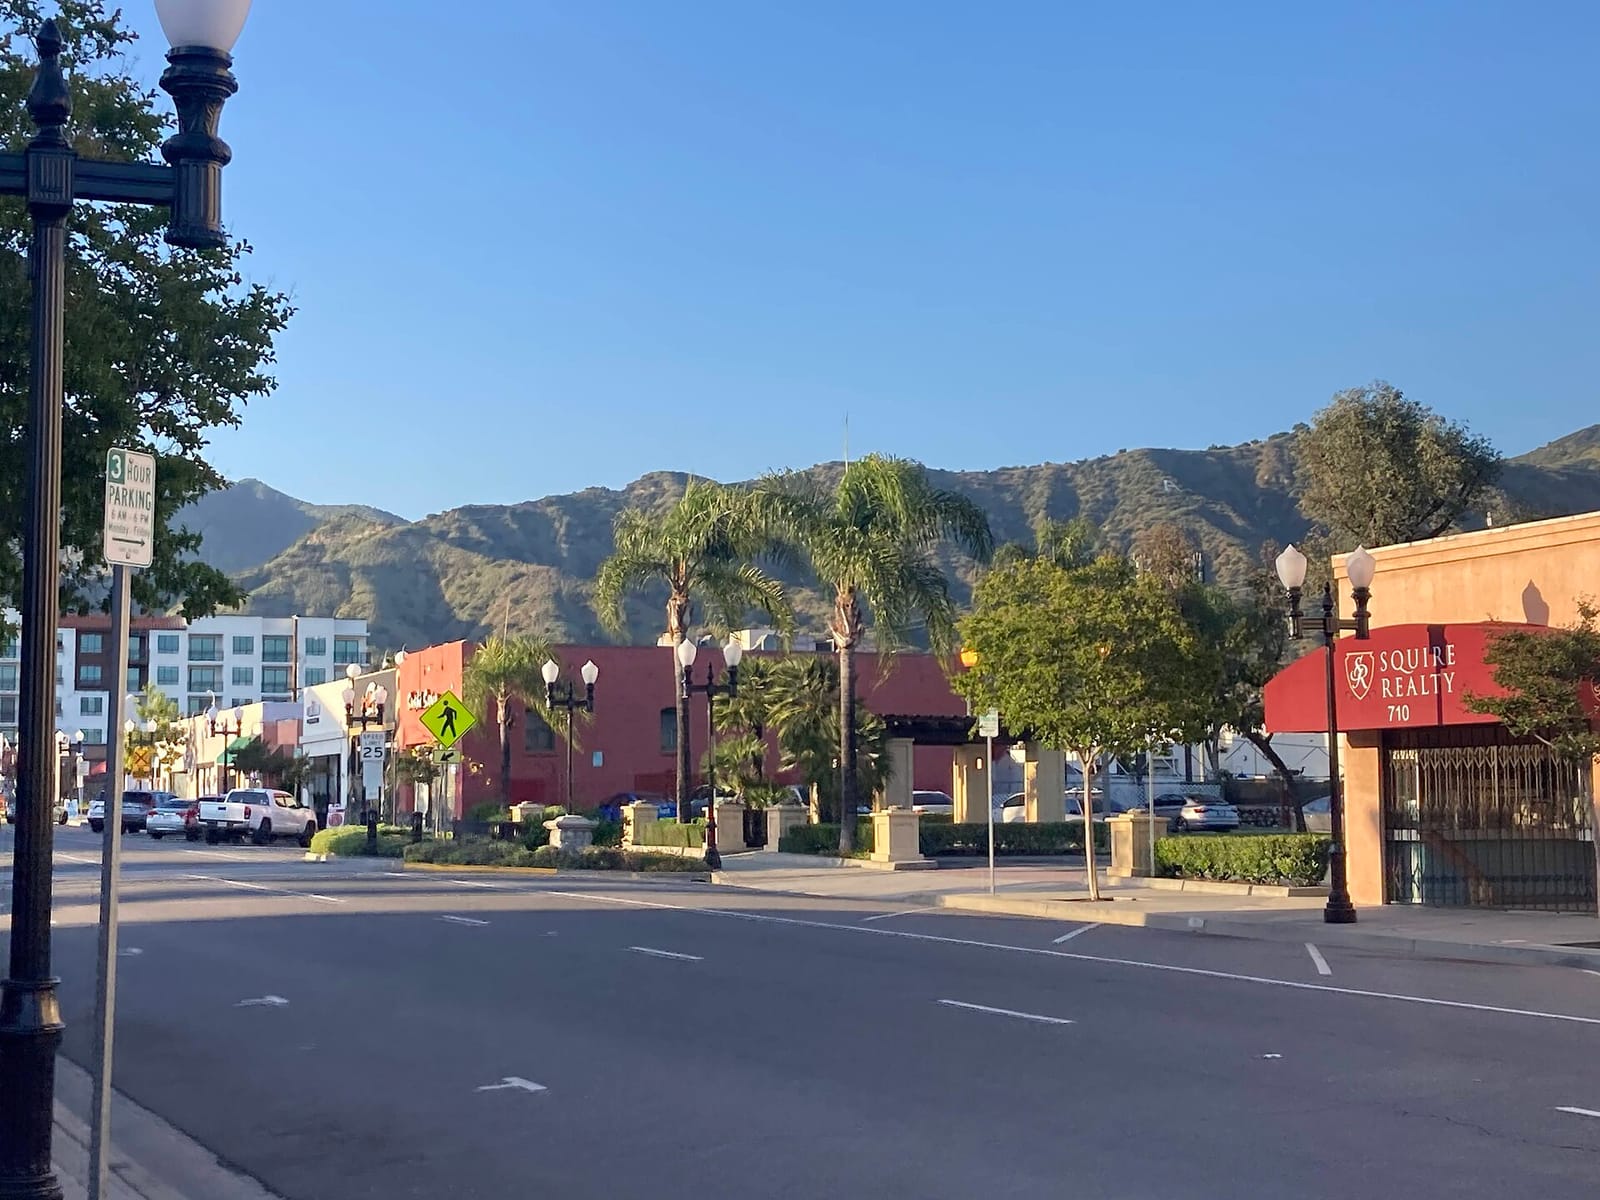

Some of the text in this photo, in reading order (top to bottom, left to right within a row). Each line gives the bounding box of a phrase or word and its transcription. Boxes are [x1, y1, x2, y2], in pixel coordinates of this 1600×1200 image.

[111, 455, 151, 485] 3 HOUR
[109, 485, 152, 511] PARKING
[117, 510, 127, 521] AM
[140, 513, 149, 524] PM
[1380, 644, 1456, 674] SQUIRE
[1381, 672, 1455, 698] REALTY
[1387, 704, 1410, 722] 710
[363, 746, 383, 758] 25
